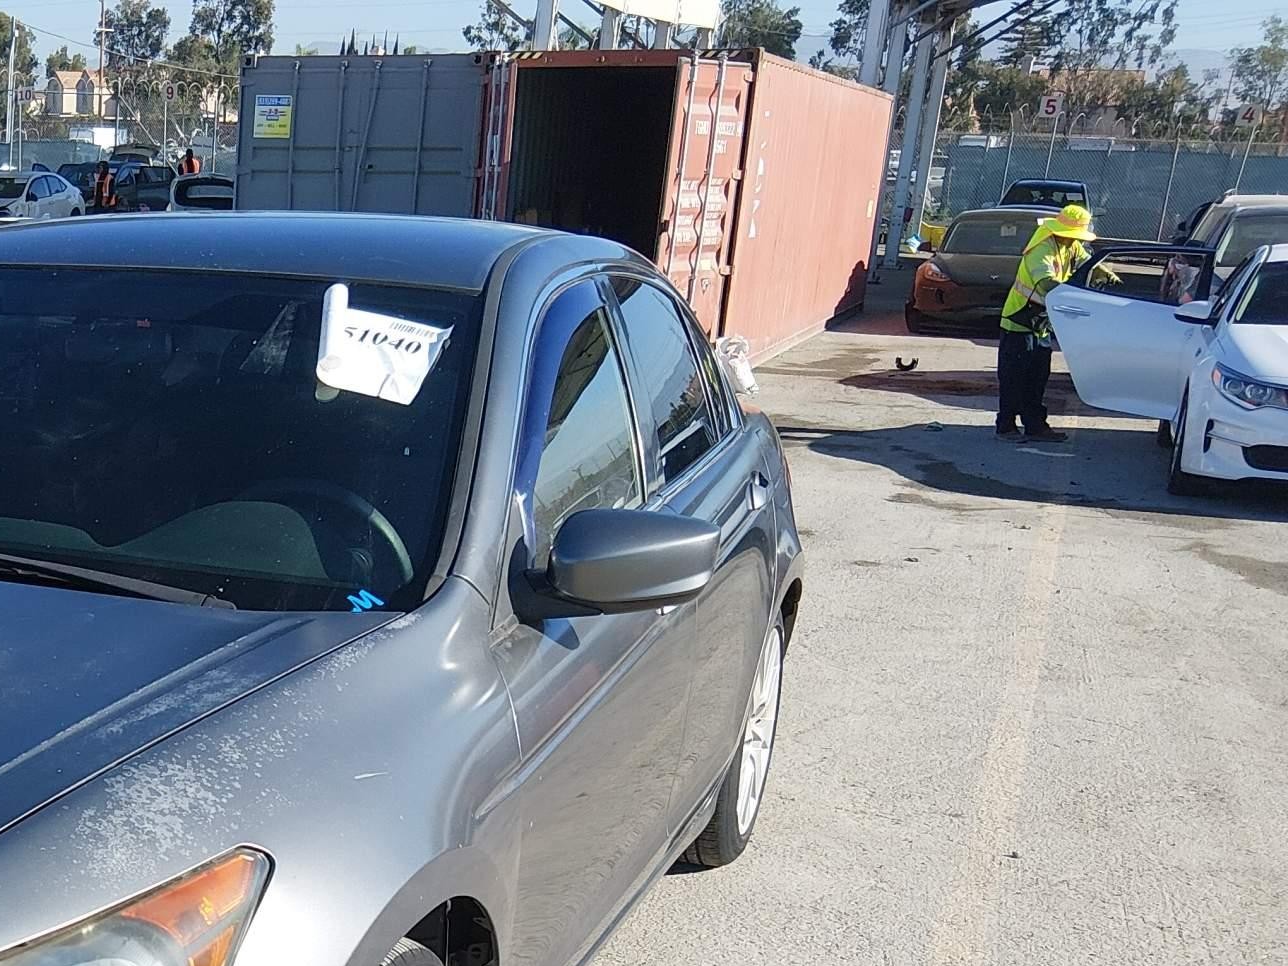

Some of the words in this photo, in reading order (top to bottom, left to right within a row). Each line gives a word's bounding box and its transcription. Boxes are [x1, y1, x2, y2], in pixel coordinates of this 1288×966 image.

[18, 90, 32, 101] 10
[166, 86, 175, 99] 9
[1044, 99, 1057, 115] 5
[1242, 106, 1255, 123] 4
